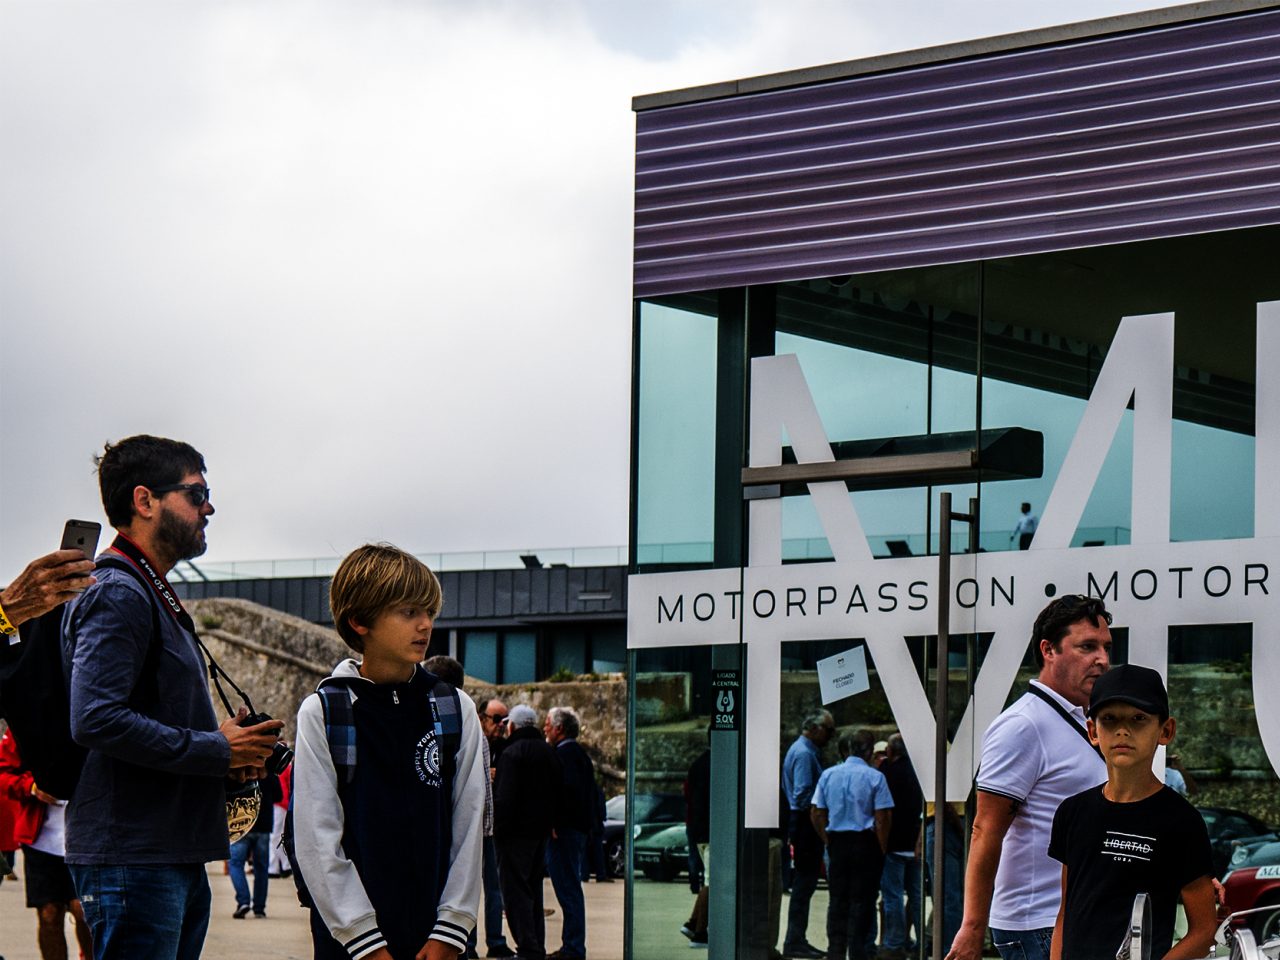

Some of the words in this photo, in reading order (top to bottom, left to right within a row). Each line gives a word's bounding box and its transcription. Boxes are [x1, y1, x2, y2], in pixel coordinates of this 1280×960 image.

[162, 590, 181, 612] EOS
[657, 576, 1015, 624] MOTORPASSON
[832, 672, 855, 684] FECHADO
[835, 678, 854, 689] CLOSED
[1103, 838, 1153, 854] LIBERTAD
